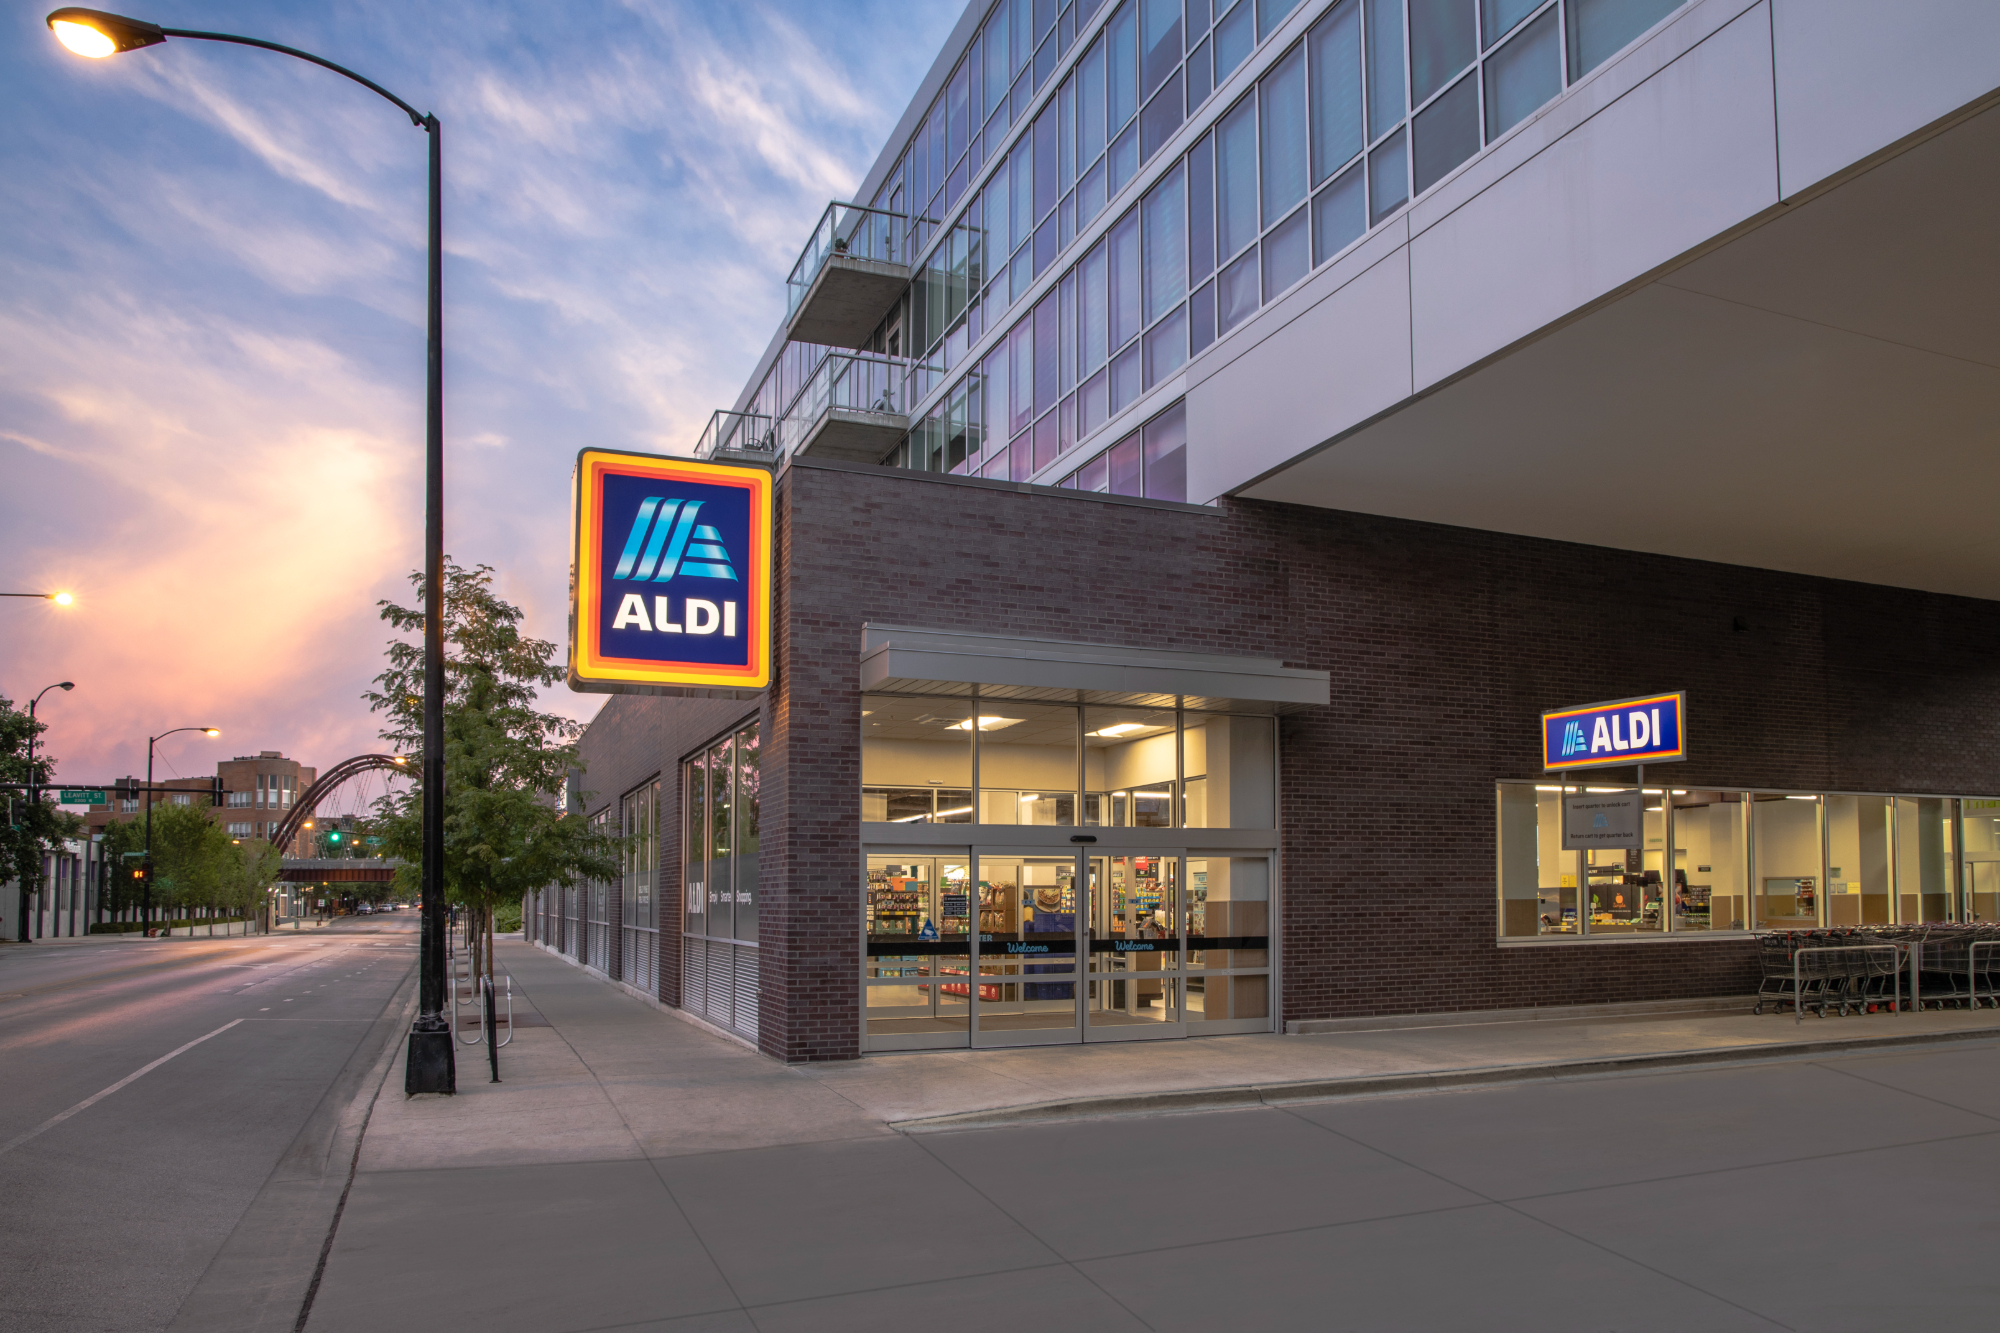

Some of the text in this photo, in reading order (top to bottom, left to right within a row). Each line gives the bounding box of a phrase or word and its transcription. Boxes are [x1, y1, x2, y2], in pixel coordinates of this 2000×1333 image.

[612, 593, 736, 637] ALDI
[1591, 708, 1660, 753] ALDI
[688, 882, 704, 913] ALDI
[721, 890, 732, 902] Smarte
[966, 934, 993, 942] ETER
[1007, 942, 1049, 953] Welcome
[1115, 940, 1154, 951] Welcome
